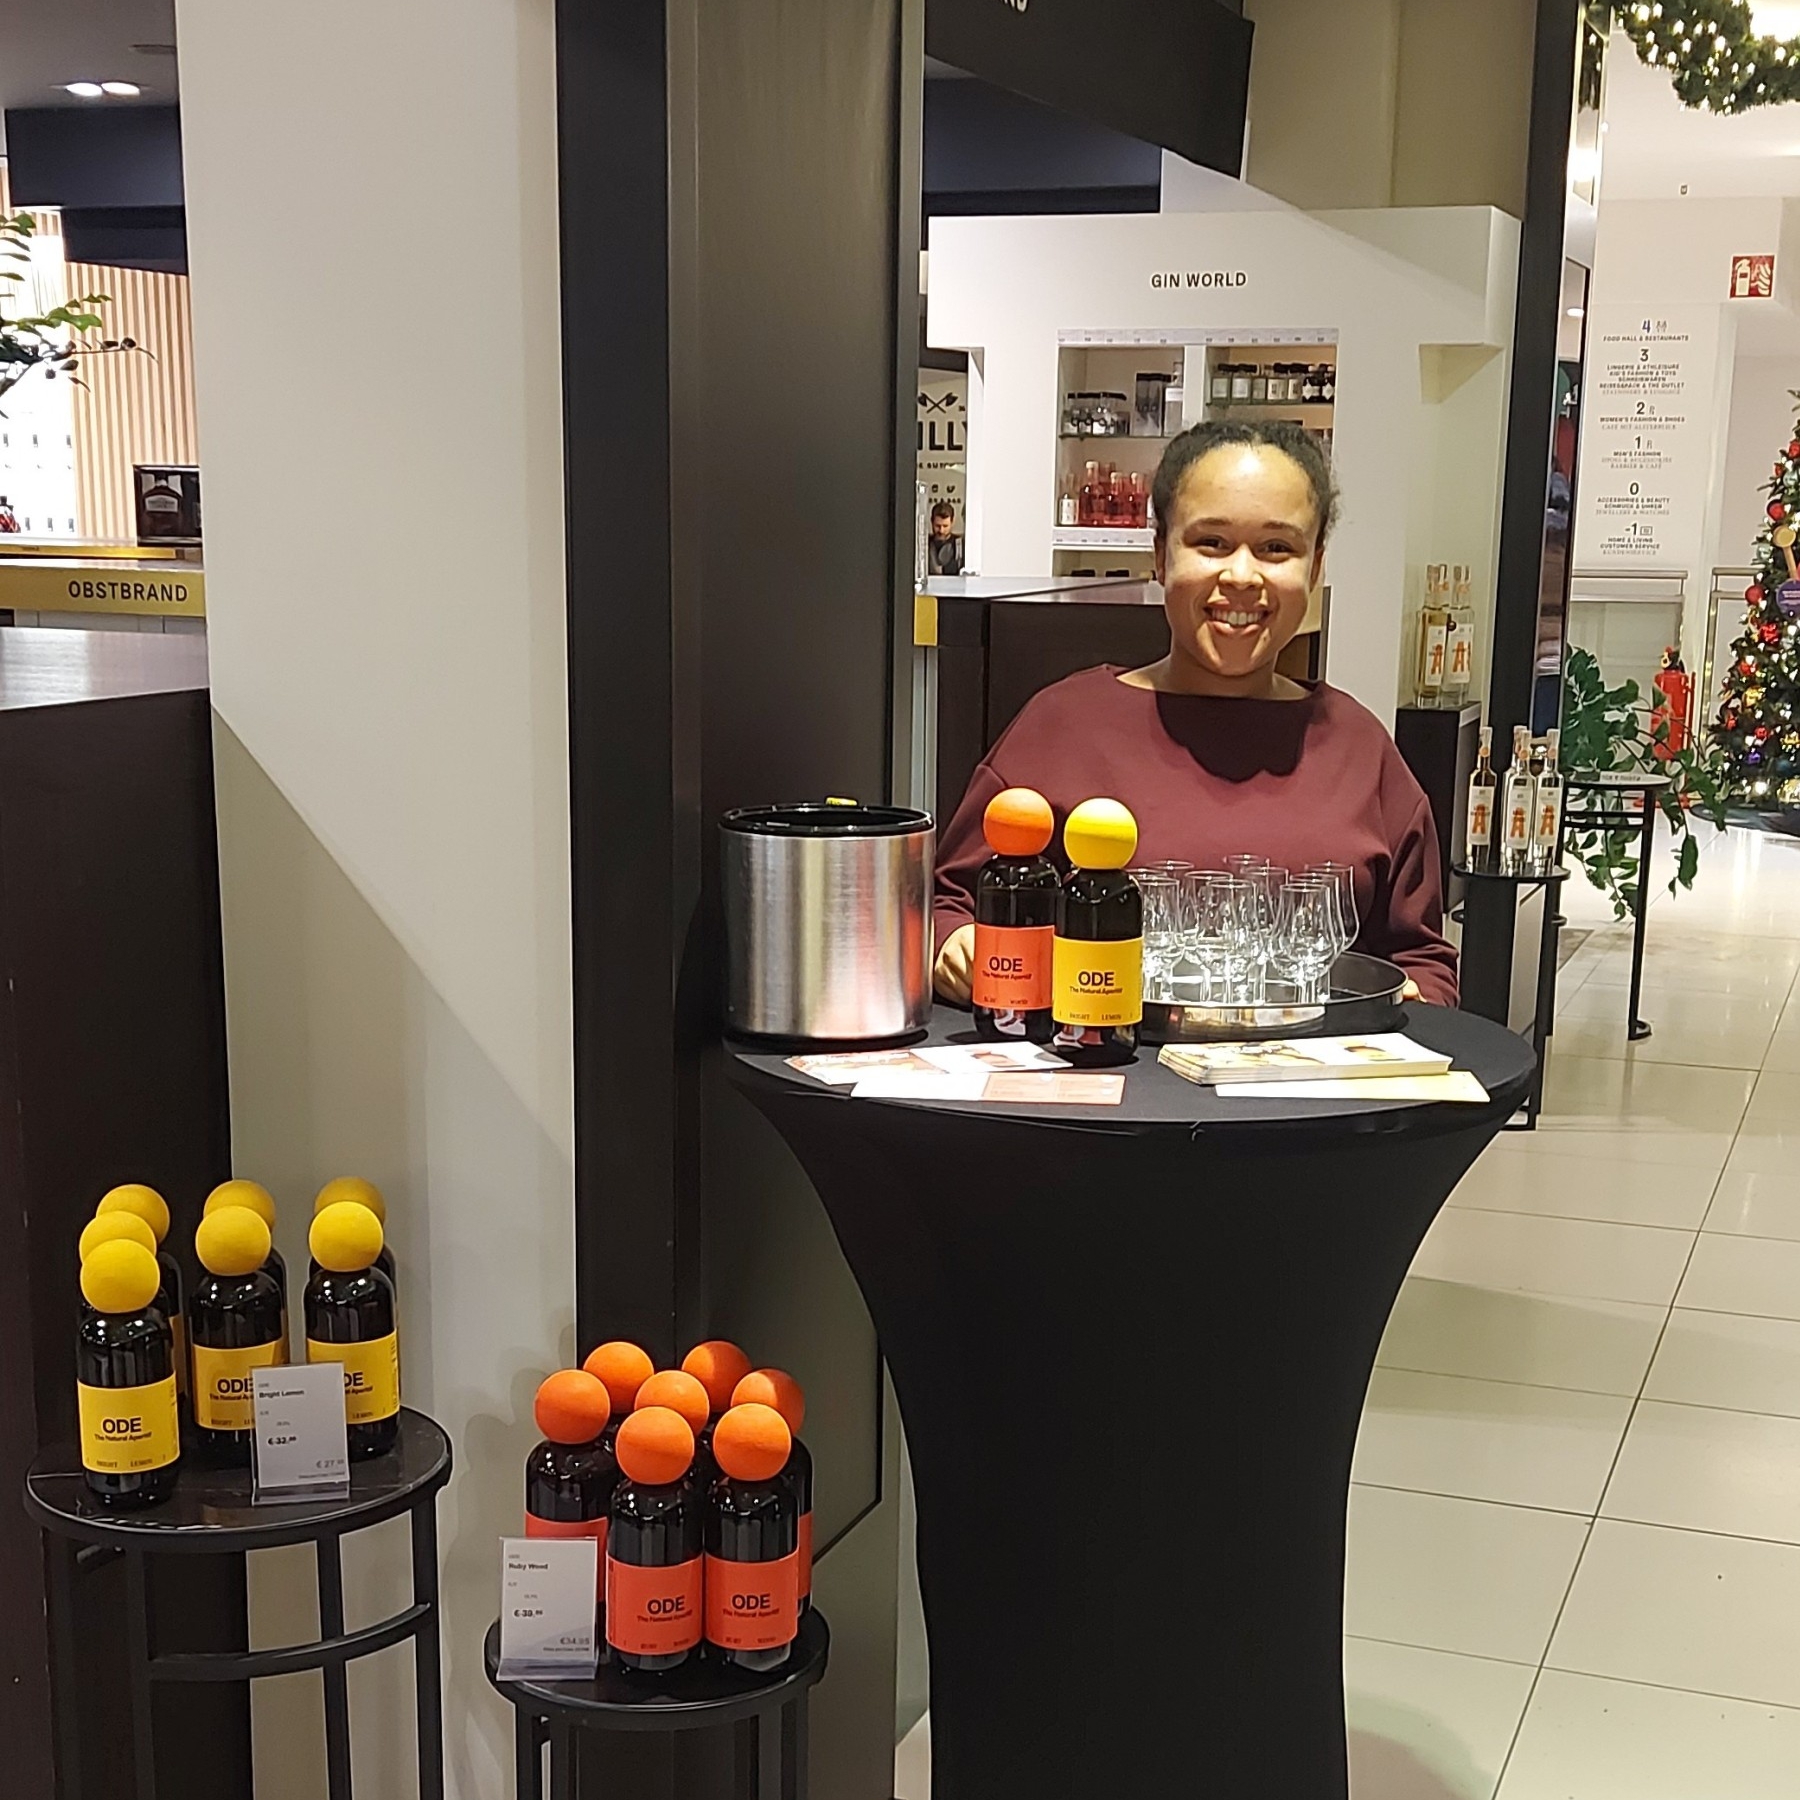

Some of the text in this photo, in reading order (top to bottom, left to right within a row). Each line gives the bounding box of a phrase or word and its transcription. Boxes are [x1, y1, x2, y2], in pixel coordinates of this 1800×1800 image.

[1151, 272, 1247, 288] GIN WORLD
[1642, 320, 1651, 333] 4
[1640, 348, 1649, 362] 3
[1636, 402, 1645, 415] 2
[1635, 436, 1641, 449] 1
[1630, 482, 1639, 495] 0
[1625, 523, 1637, 535] -1
[68, 580, 187, 602] OBSTBRAND
[989, 956, 1023, 972] ODE
[1078, 971, 1115, 986] ODE
[102, 1417, 142, 1434] ODE
[509, 1563, 527, 1571] Ruby
[647, 1595, 685, 1615] ODE
[732, 1593, 771, 1610] ODE
